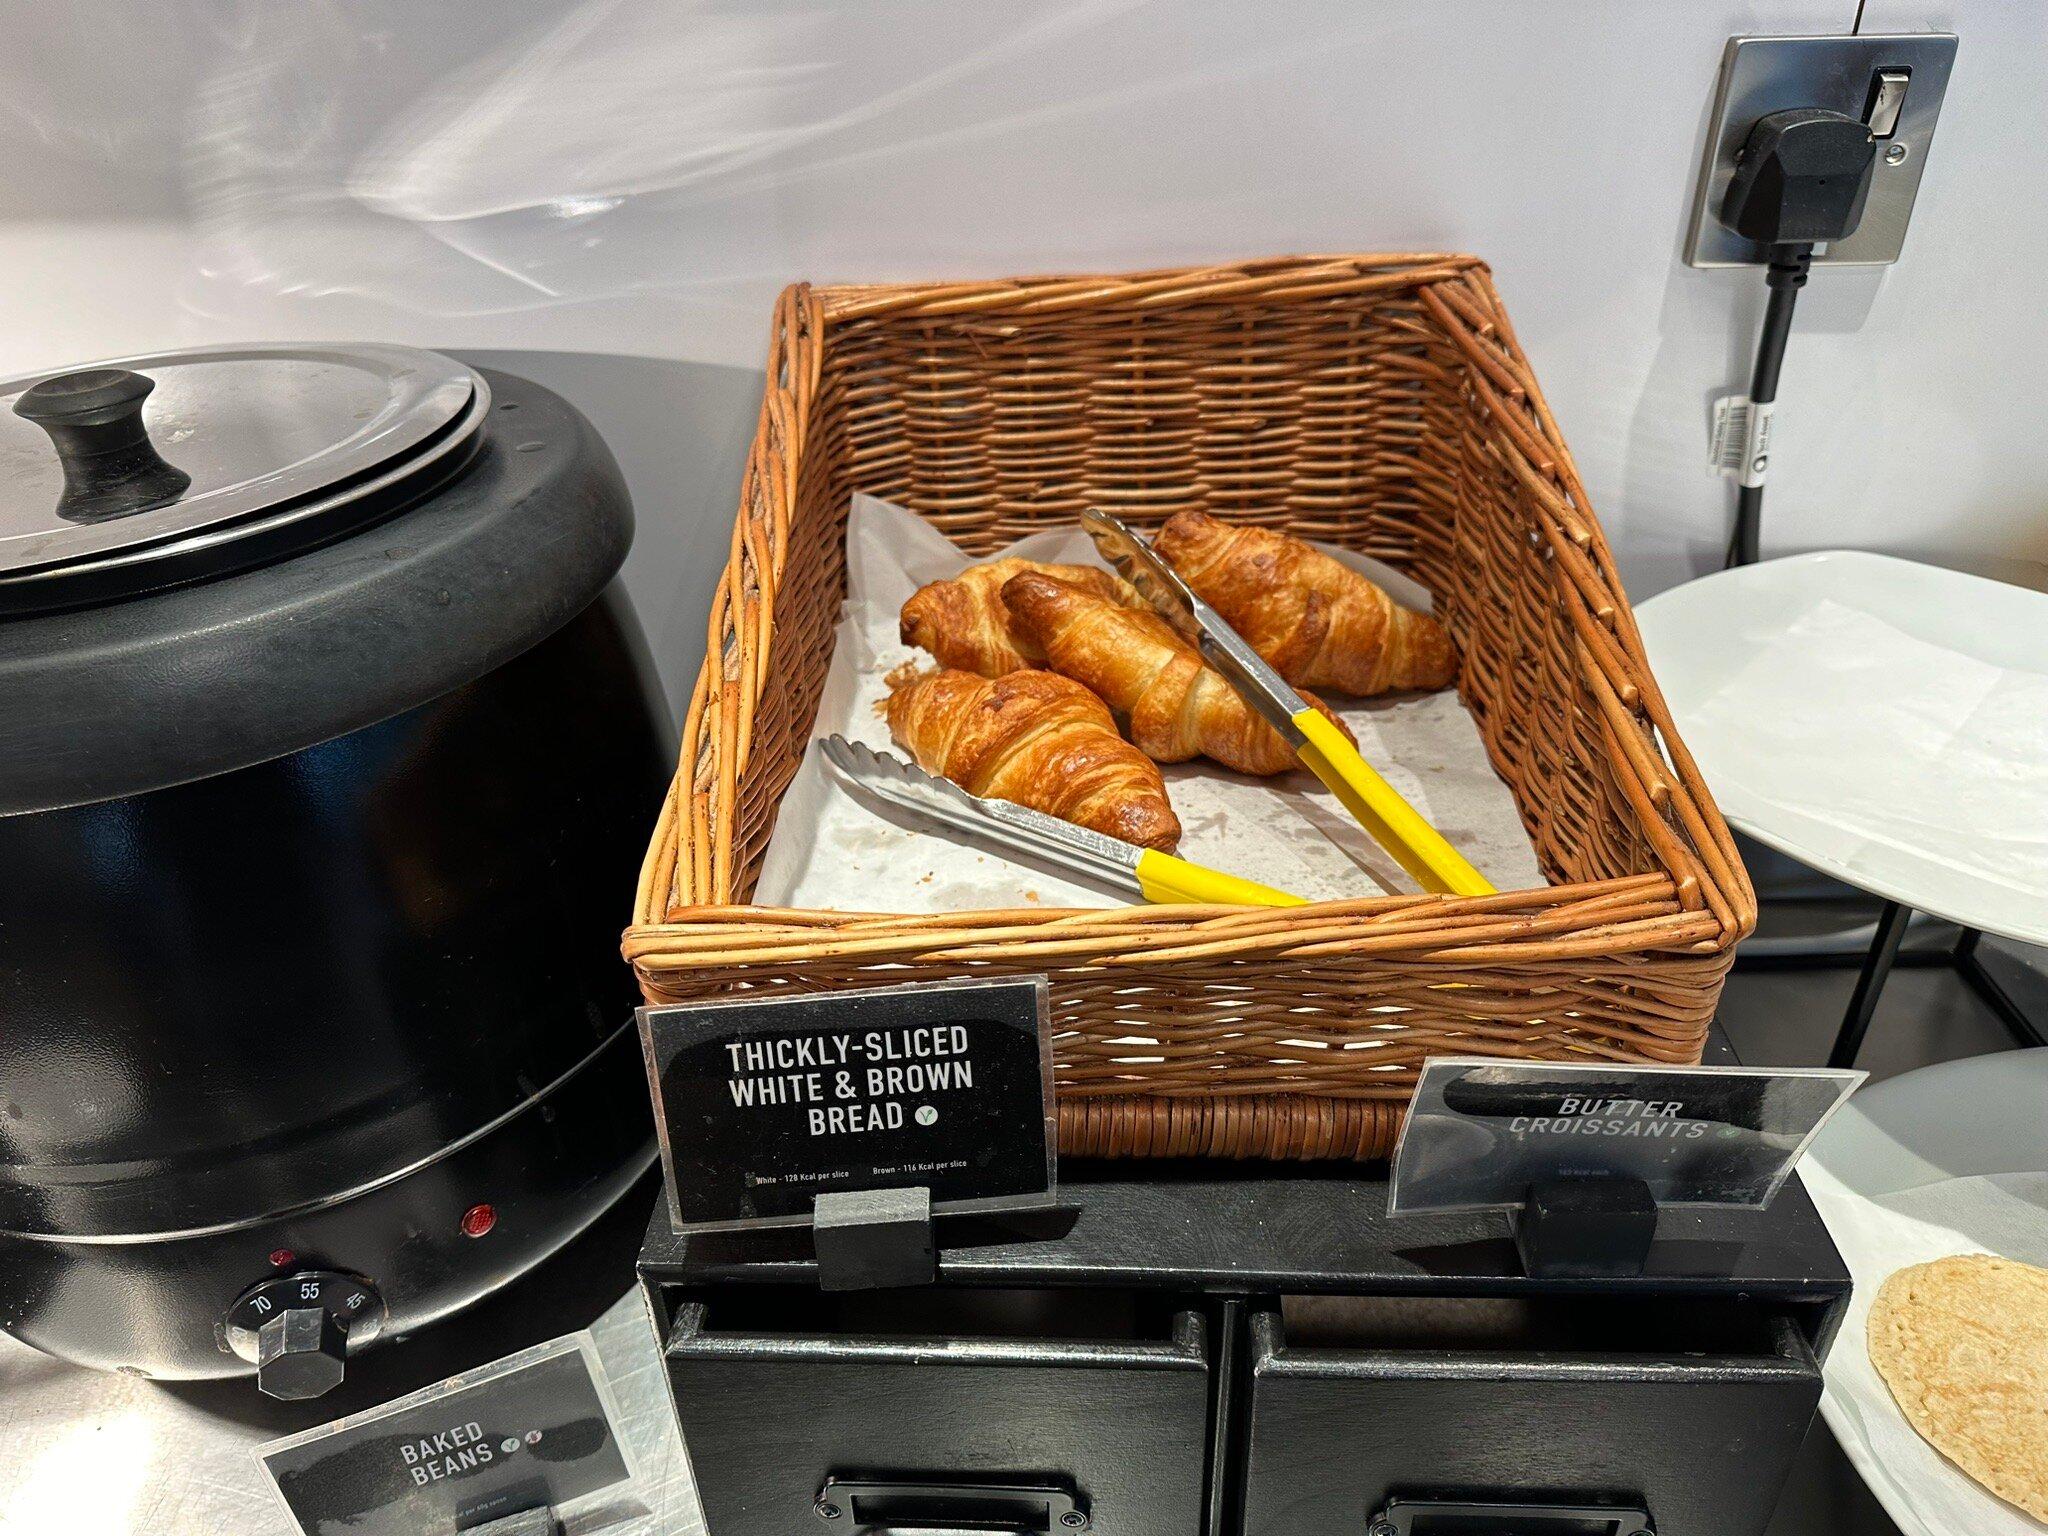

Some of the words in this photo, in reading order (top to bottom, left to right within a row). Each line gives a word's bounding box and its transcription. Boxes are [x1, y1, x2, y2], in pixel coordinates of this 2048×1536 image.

[725, 1025, 969, 1073] THICKLY-SLICED
[728, 1072, 824, 1108] WHITE
[835, 1070, 857, 1099] &
[866, 1060, 974, 1097] BROWN
[807, 1101, 904, 1136] BREAD
[1557, 1097, 1684, 1119] BUTTER
[1508, 1116, 1709, 1139] CROISSANTS
[756, 1176, 777, 1185] White
[785, 1174, 798, 1182] 128
[800, 1172, 816, 1181] Kcal
[818, 1173, 830, 1181] per
[832, 1170, 849, 1178] slice
[873, 1166, 896, 1175] Brown
[904, 1164, 917, 1172] 116
[918, 1162, 934, 1171] Kcal
[936, 1162, 948, 1171] per
[950, 1160, 967, 1168] slice
[300, 1282, 320, 1300] 55
[346, 1292, 366, 1309] 45
[250, 1295, 272, 1315] 70
[400, 1421, 484, 1465] BAKED
[411, 1443, 493, 1486] BEANS
